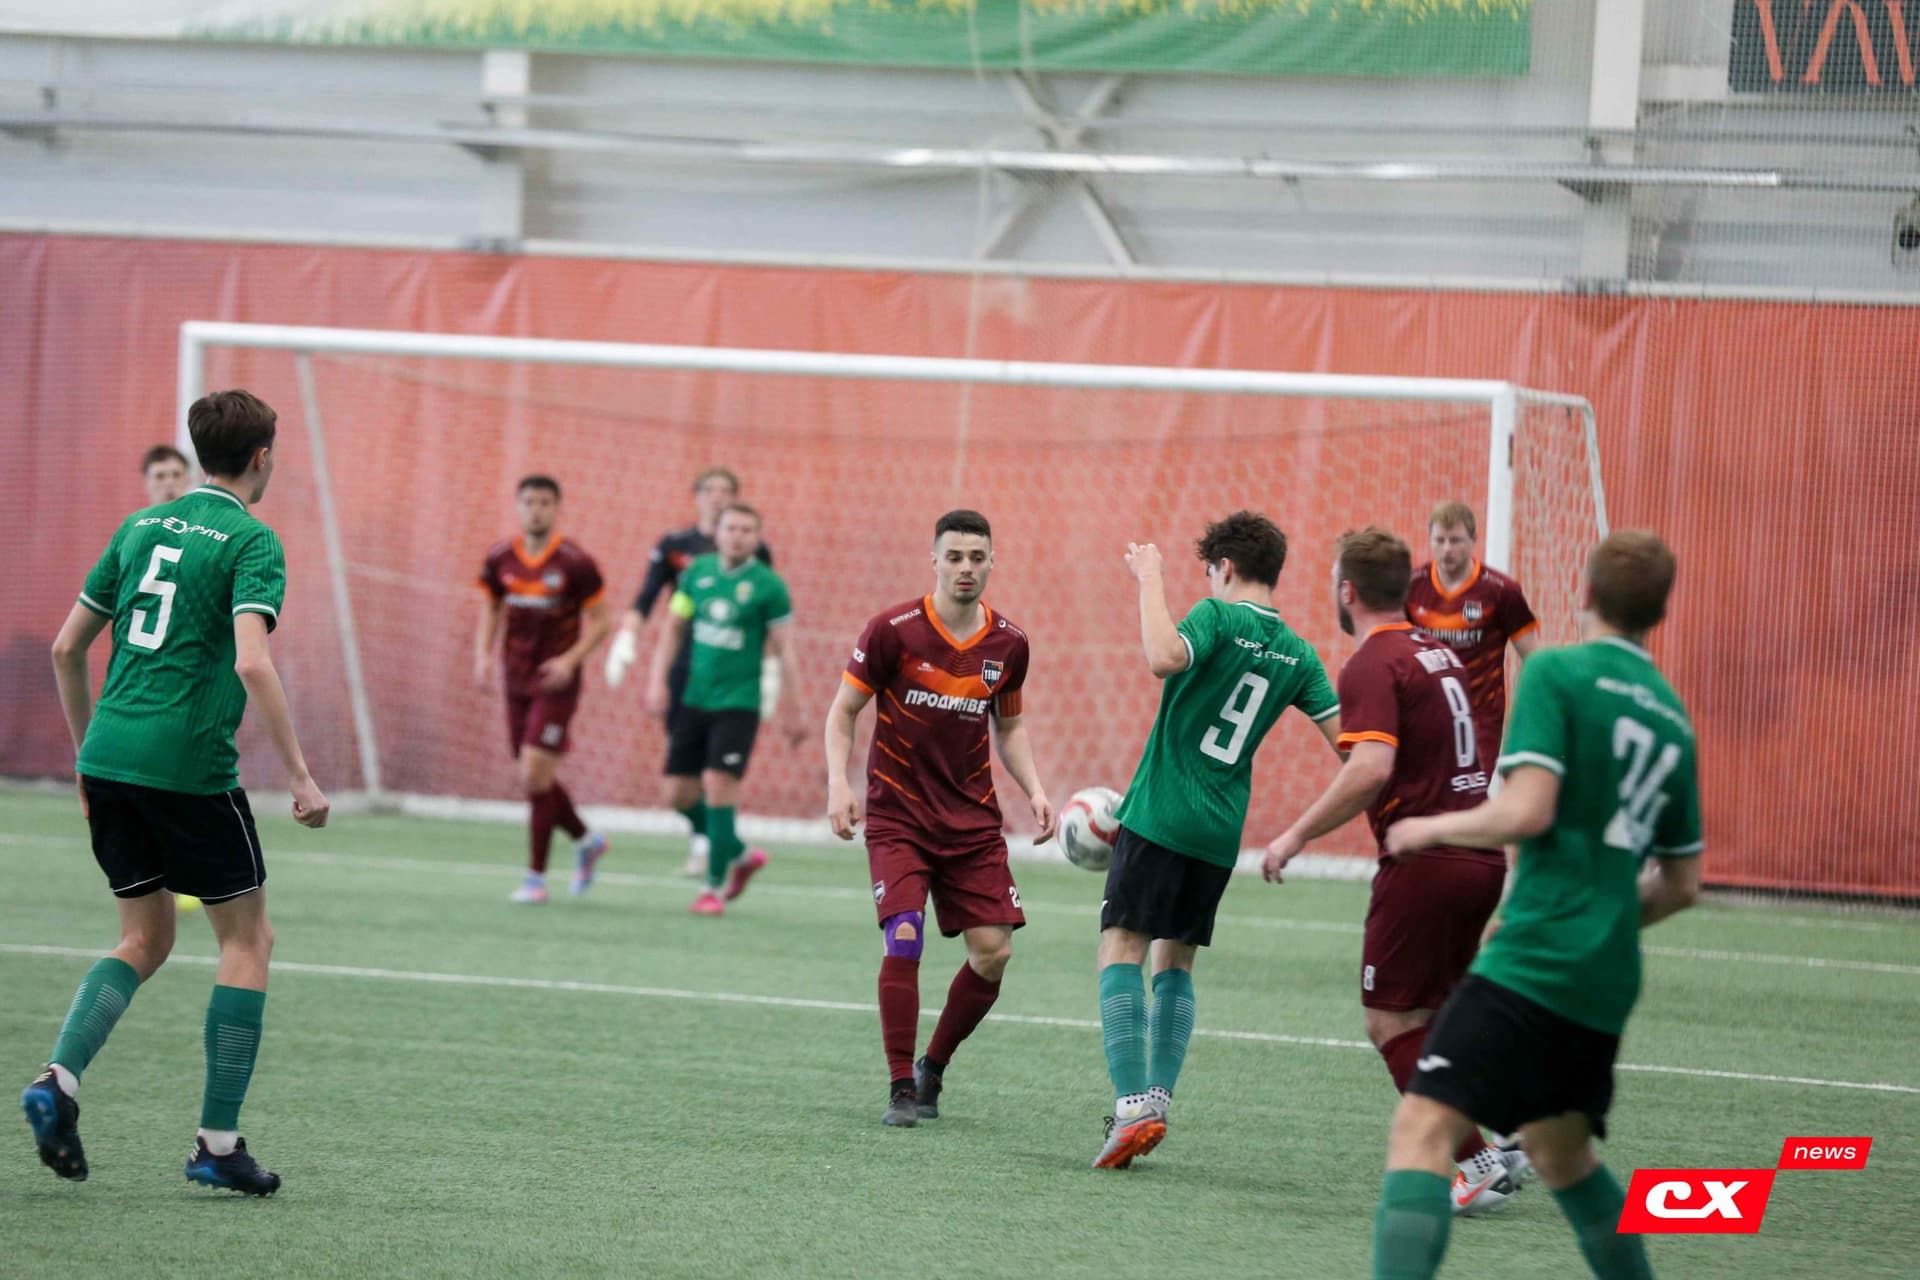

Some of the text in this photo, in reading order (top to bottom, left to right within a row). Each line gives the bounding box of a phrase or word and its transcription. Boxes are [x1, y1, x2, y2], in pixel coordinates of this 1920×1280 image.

[127, 544, 183, 650] 5
[905, 688, 991, 714] ПРОДИНВЕ
[1200, 671, 1270, 765] 9
[1363, 965, 1376, 991] 8
